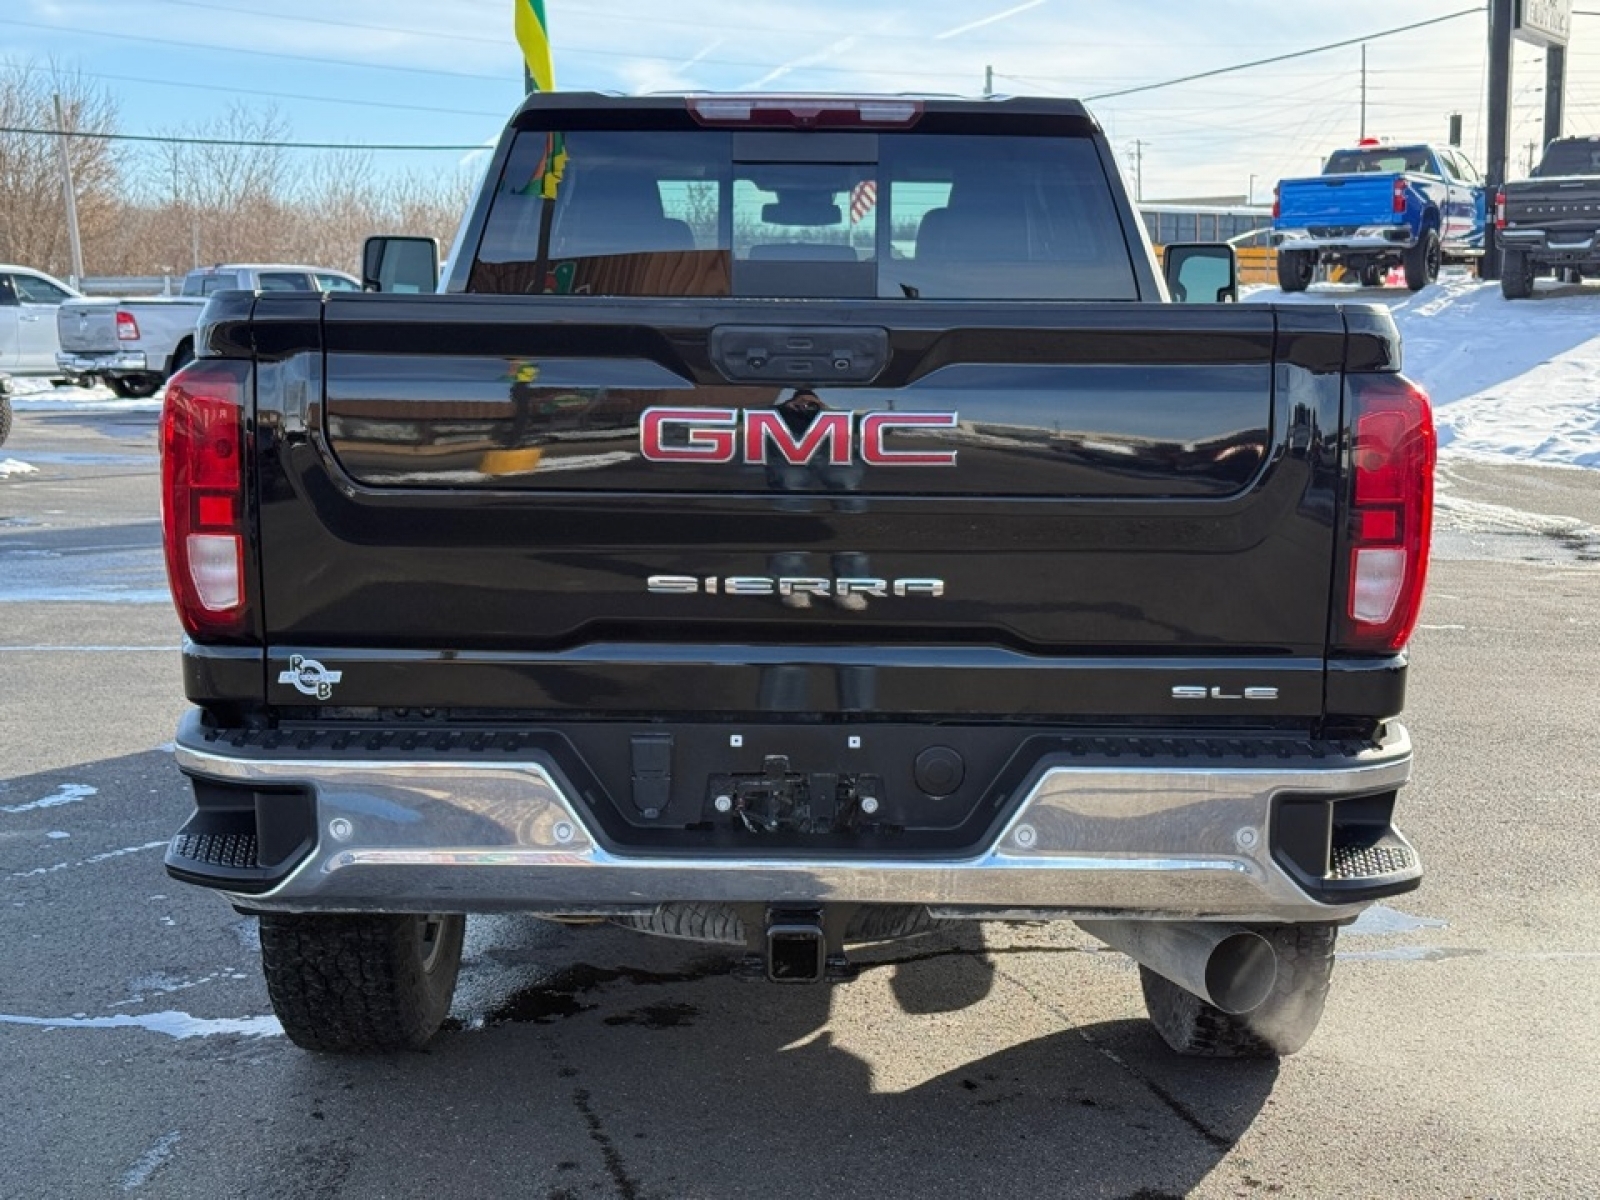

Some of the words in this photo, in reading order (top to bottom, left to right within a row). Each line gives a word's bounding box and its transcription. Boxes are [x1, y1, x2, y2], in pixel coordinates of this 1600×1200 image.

[640, 407, 958, 467] GMC
[647, 575, 945, 598] SIERRA
[1172, 685, 1279, 699] SLE
